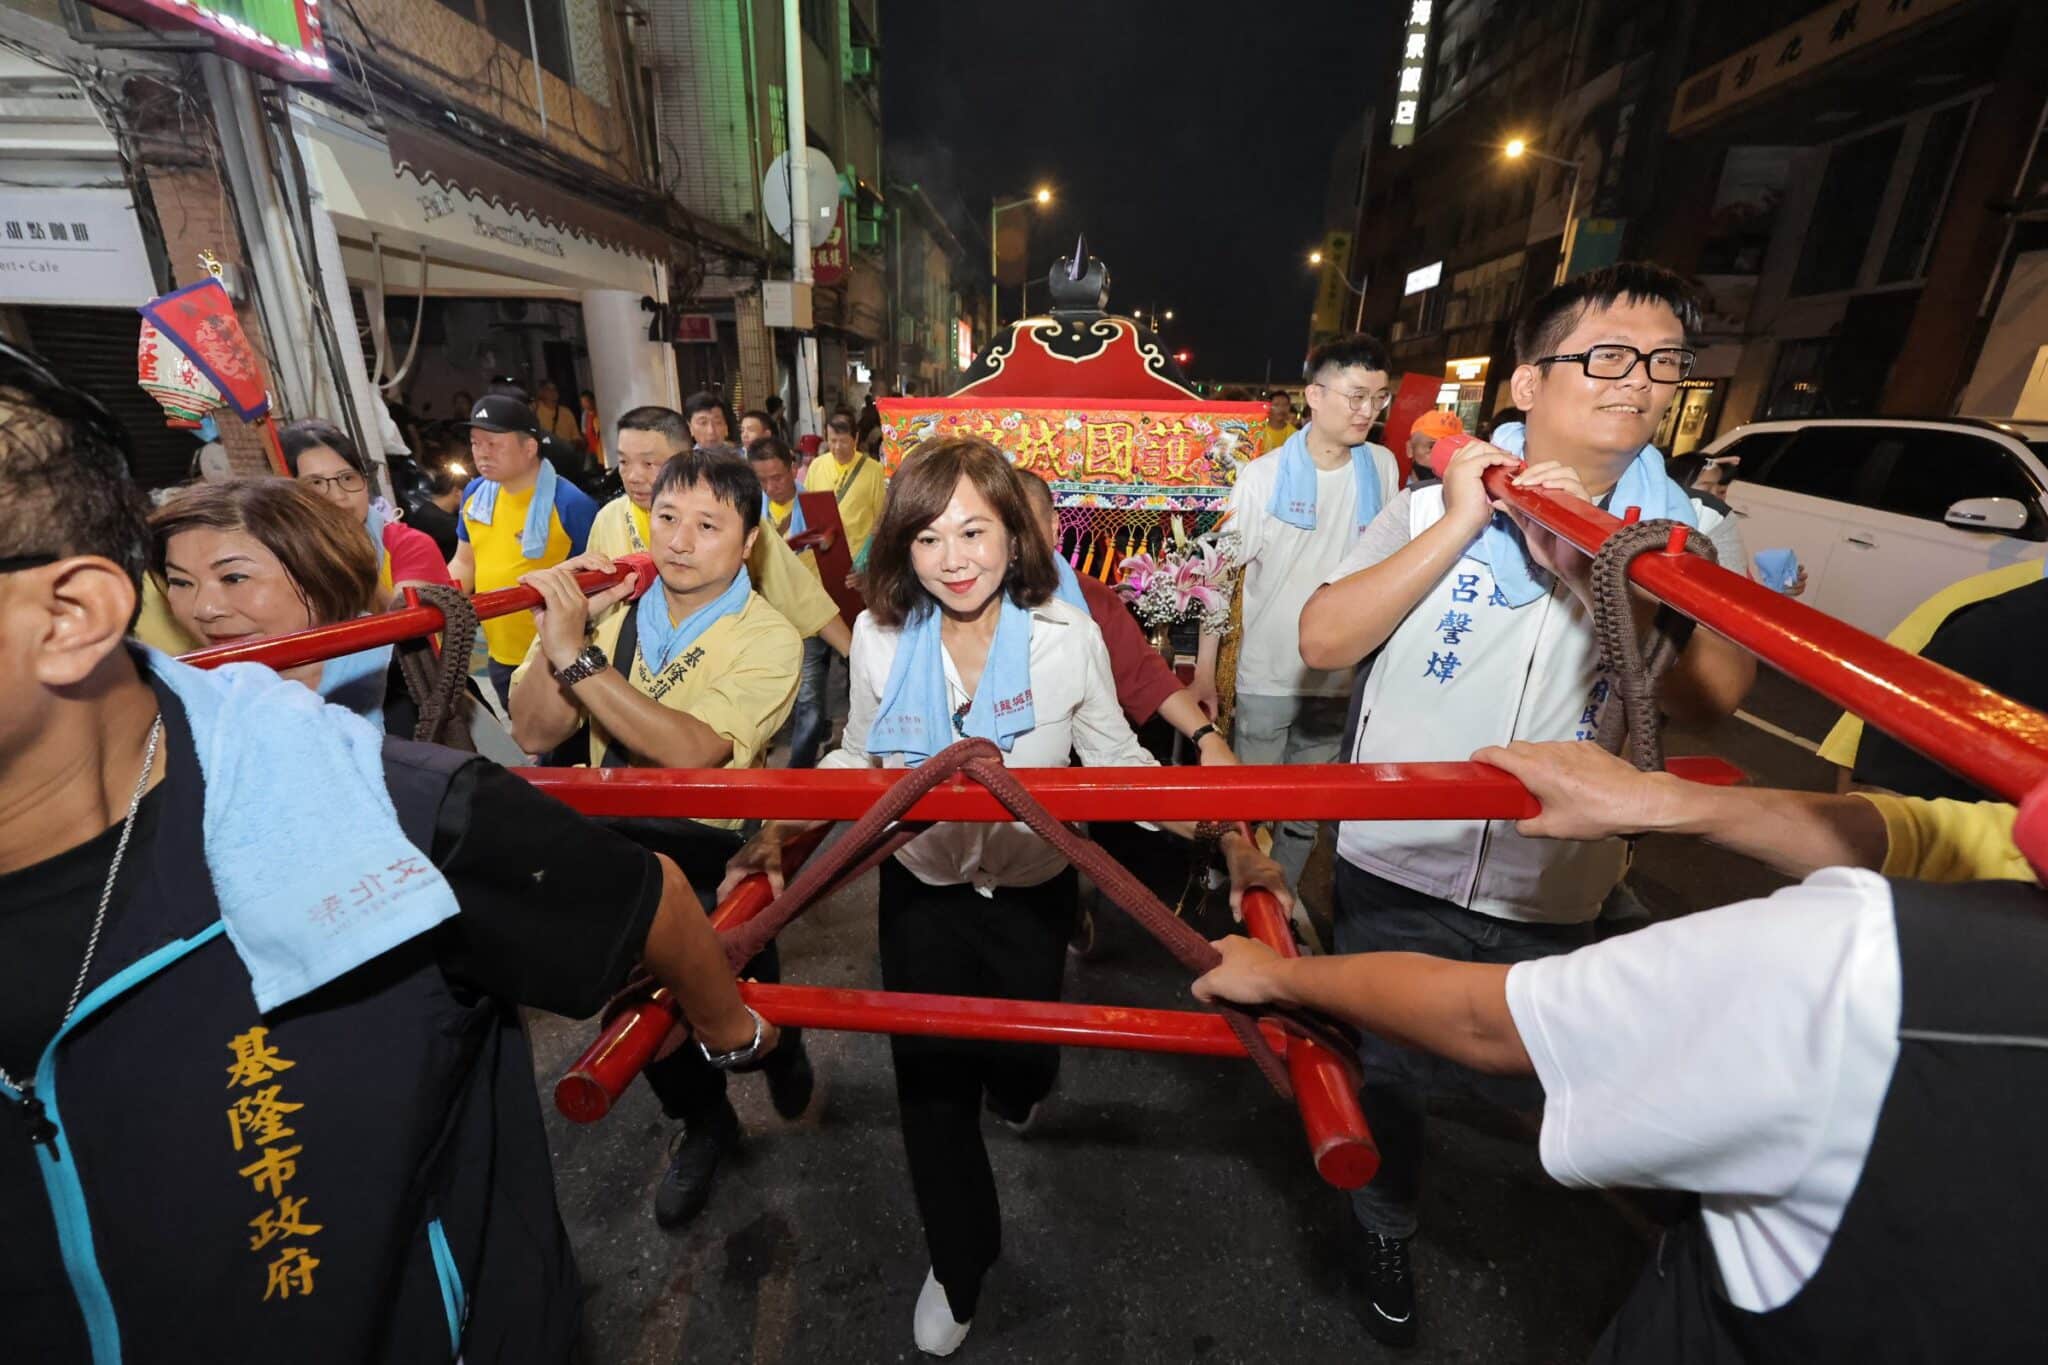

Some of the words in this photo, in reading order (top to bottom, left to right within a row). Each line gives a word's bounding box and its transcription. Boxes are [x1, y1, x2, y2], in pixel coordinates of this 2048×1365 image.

[226, 1026, 324, 1302] 基隆市政府
